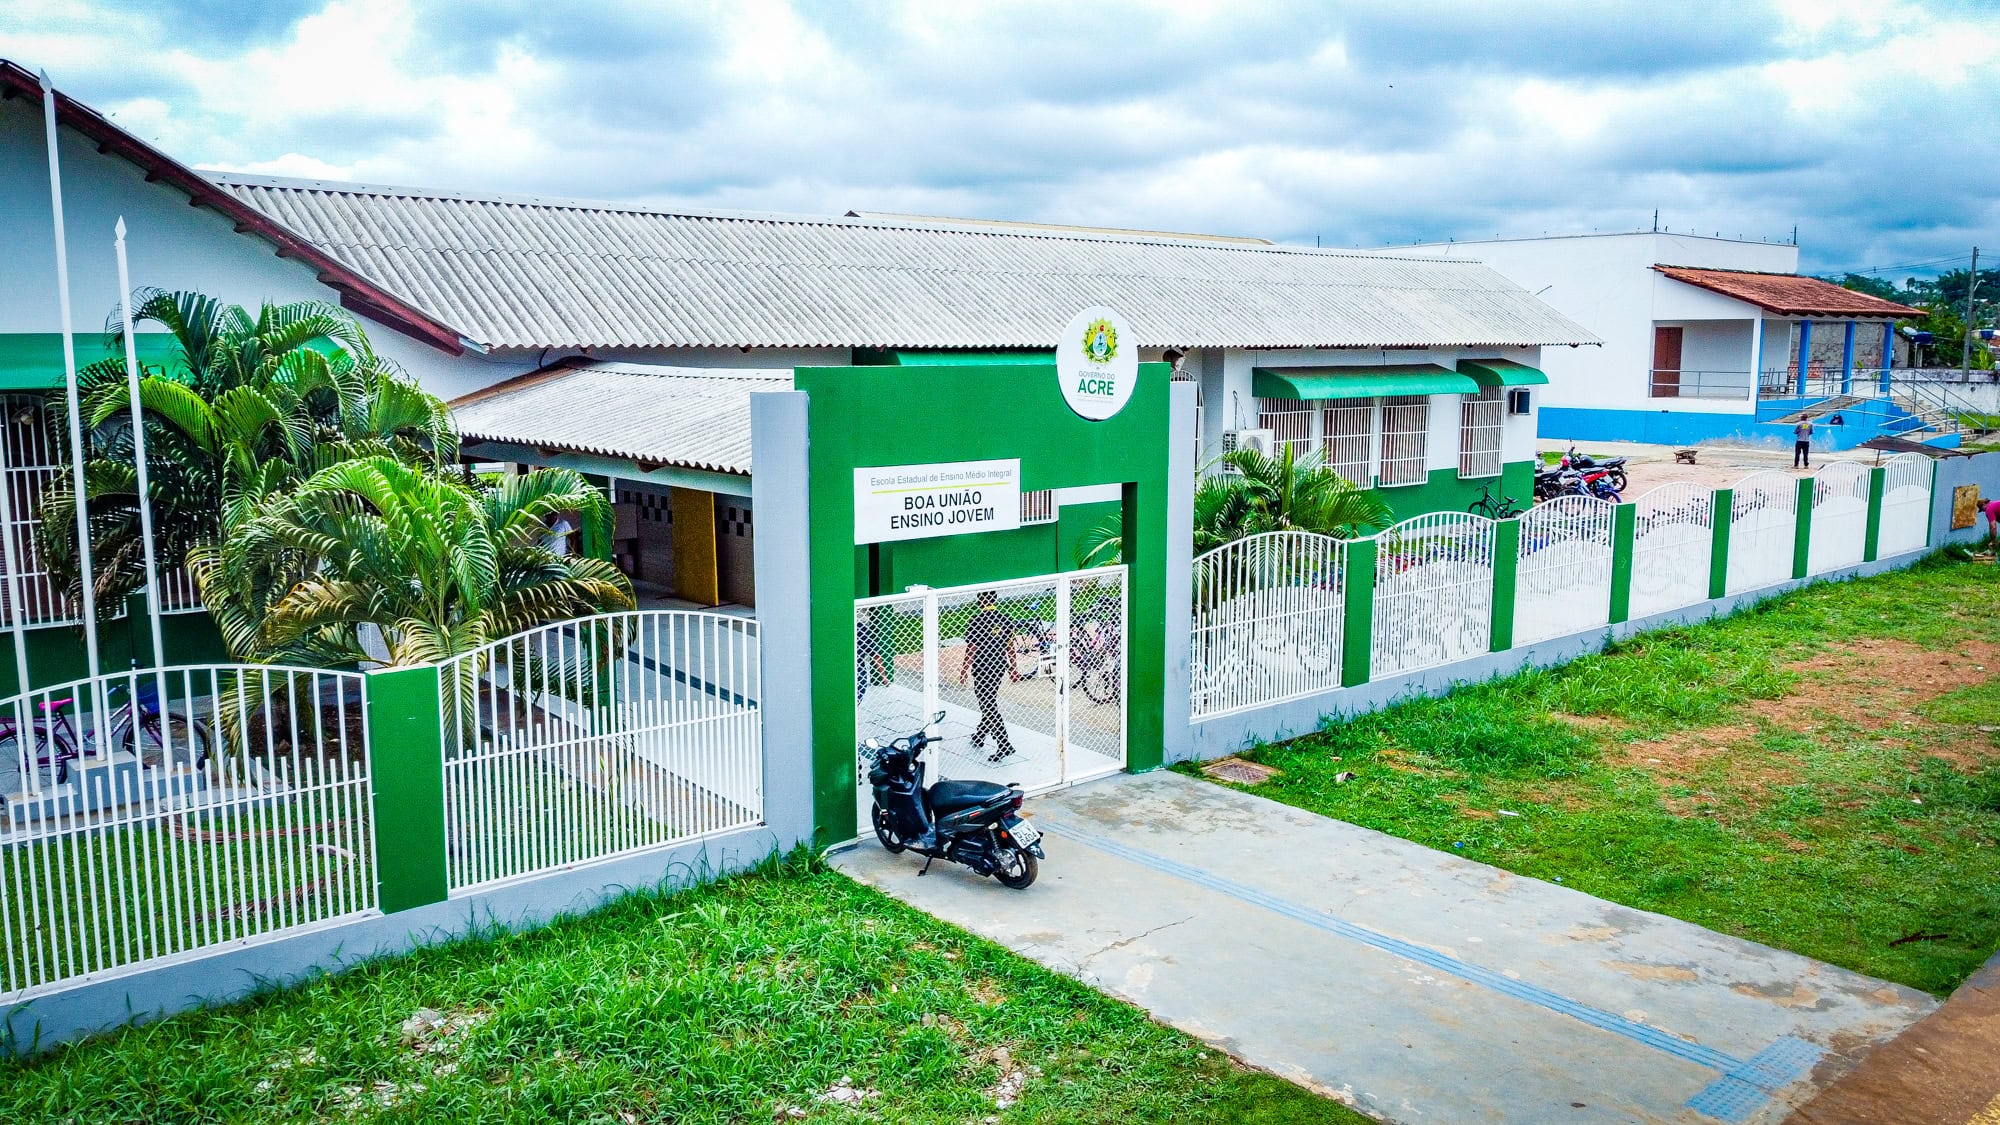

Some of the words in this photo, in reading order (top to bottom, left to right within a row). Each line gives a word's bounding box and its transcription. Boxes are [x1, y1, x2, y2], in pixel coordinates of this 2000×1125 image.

[1078, 371, 1106, 379] GOVERNO
[1077, 378, 1115, 396] ACRE
[870, 477, 896, 487] Escola
[897, 473, 928, 485] Estadual
[929, 473, 939, 482] de
[940, 471, 964, 481] Ensino
[965, 469, 986, 480] Médio
[987, 468, 1012, 481] Integral
[904, 495, 935, 510] BOA
[939, 489, 982, 507] UNIÃO
[890, 511, 944, 530] ENSINO
[948, 507, 995, 524] JOVEM
